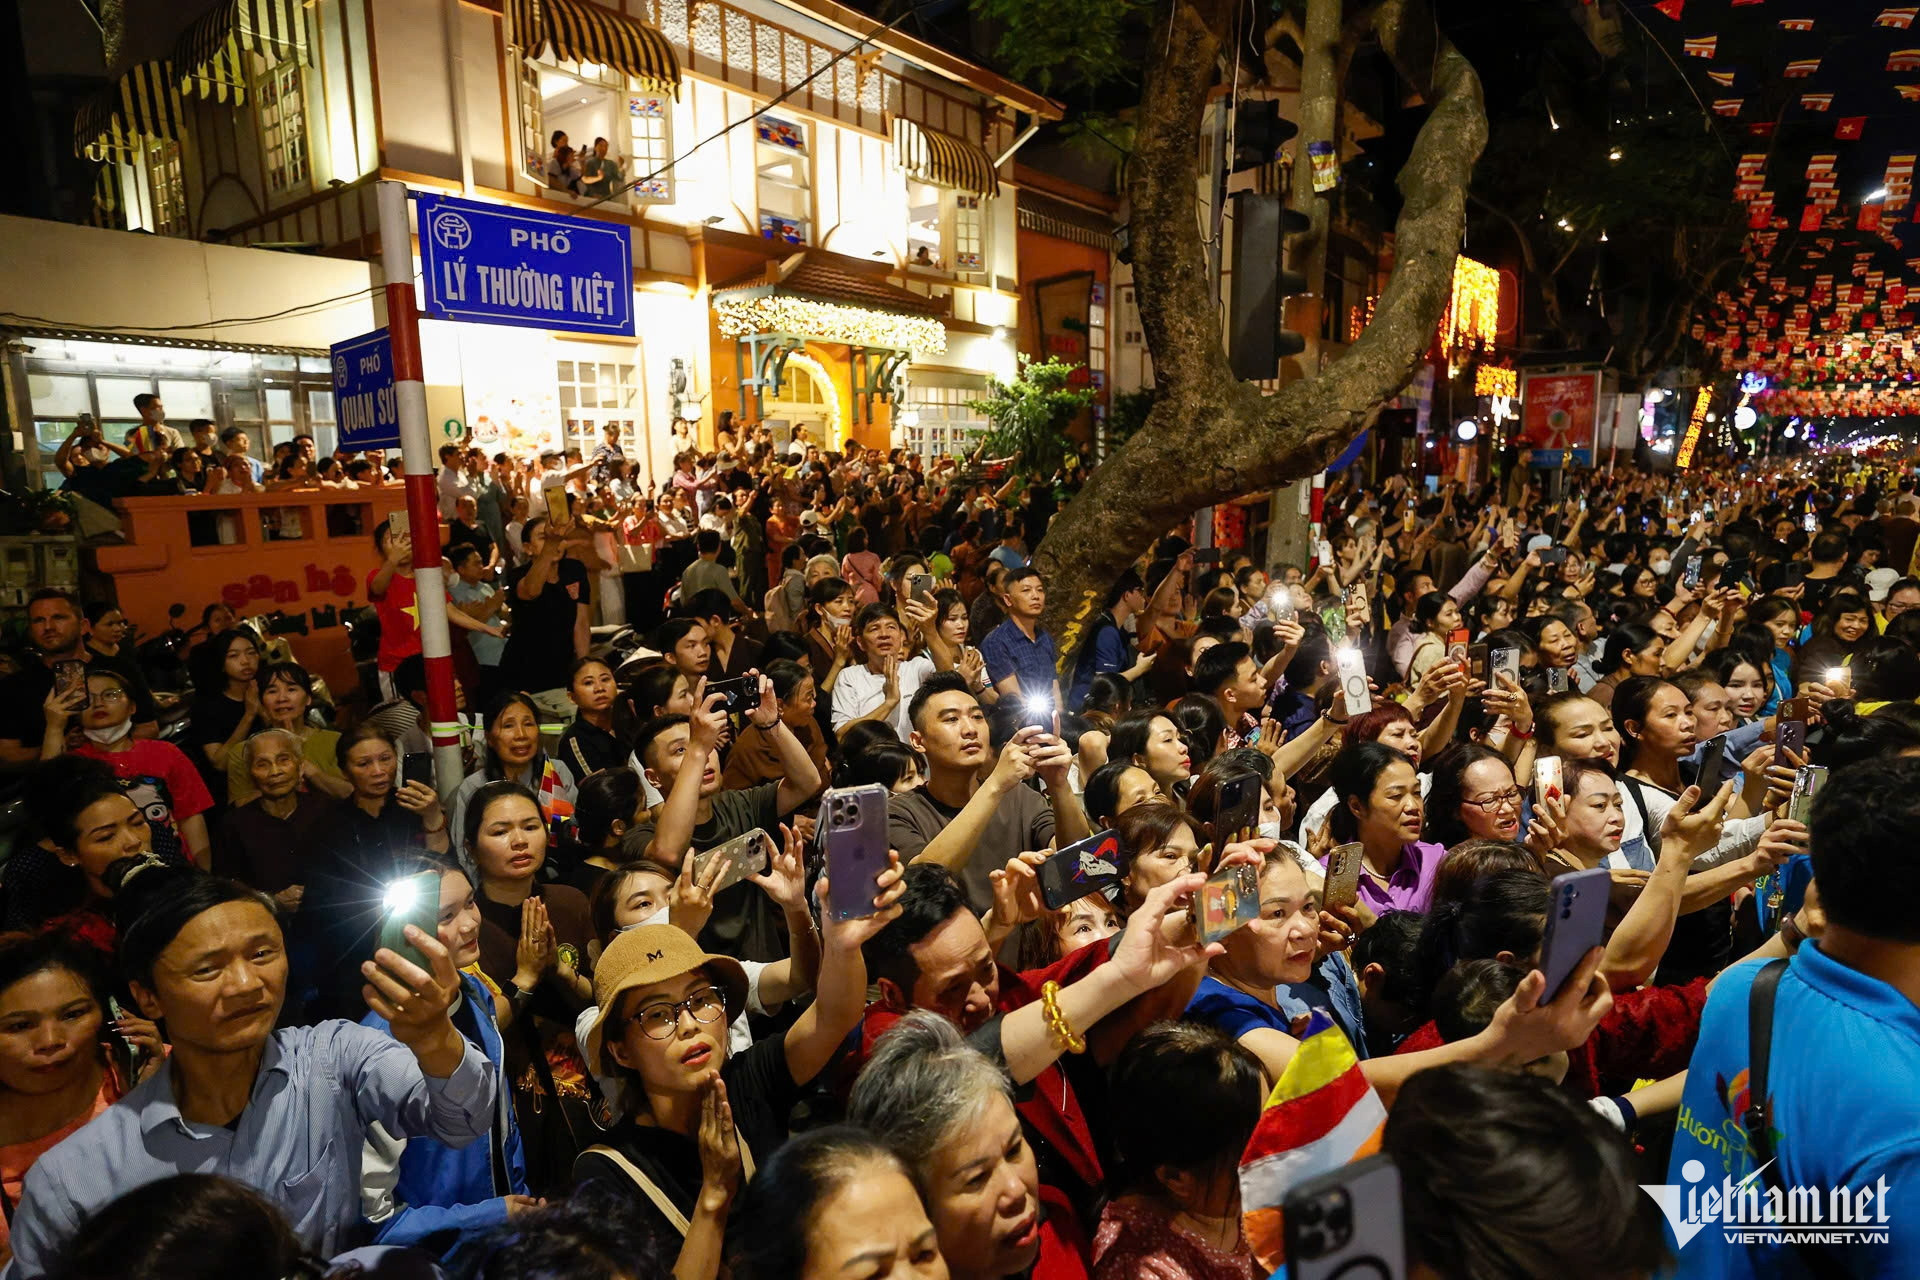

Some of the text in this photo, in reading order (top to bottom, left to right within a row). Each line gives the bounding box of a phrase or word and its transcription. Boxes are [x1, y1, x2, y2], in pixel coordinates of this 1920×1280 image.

[511, 228, 571, 254] PHỐ
[443, 256, 615, 320] LÝ THƯỜNG KIỆT
[360, 345, 380, 376] PHỐ
[341, 378, 396, 434] QUÁN SỨ
